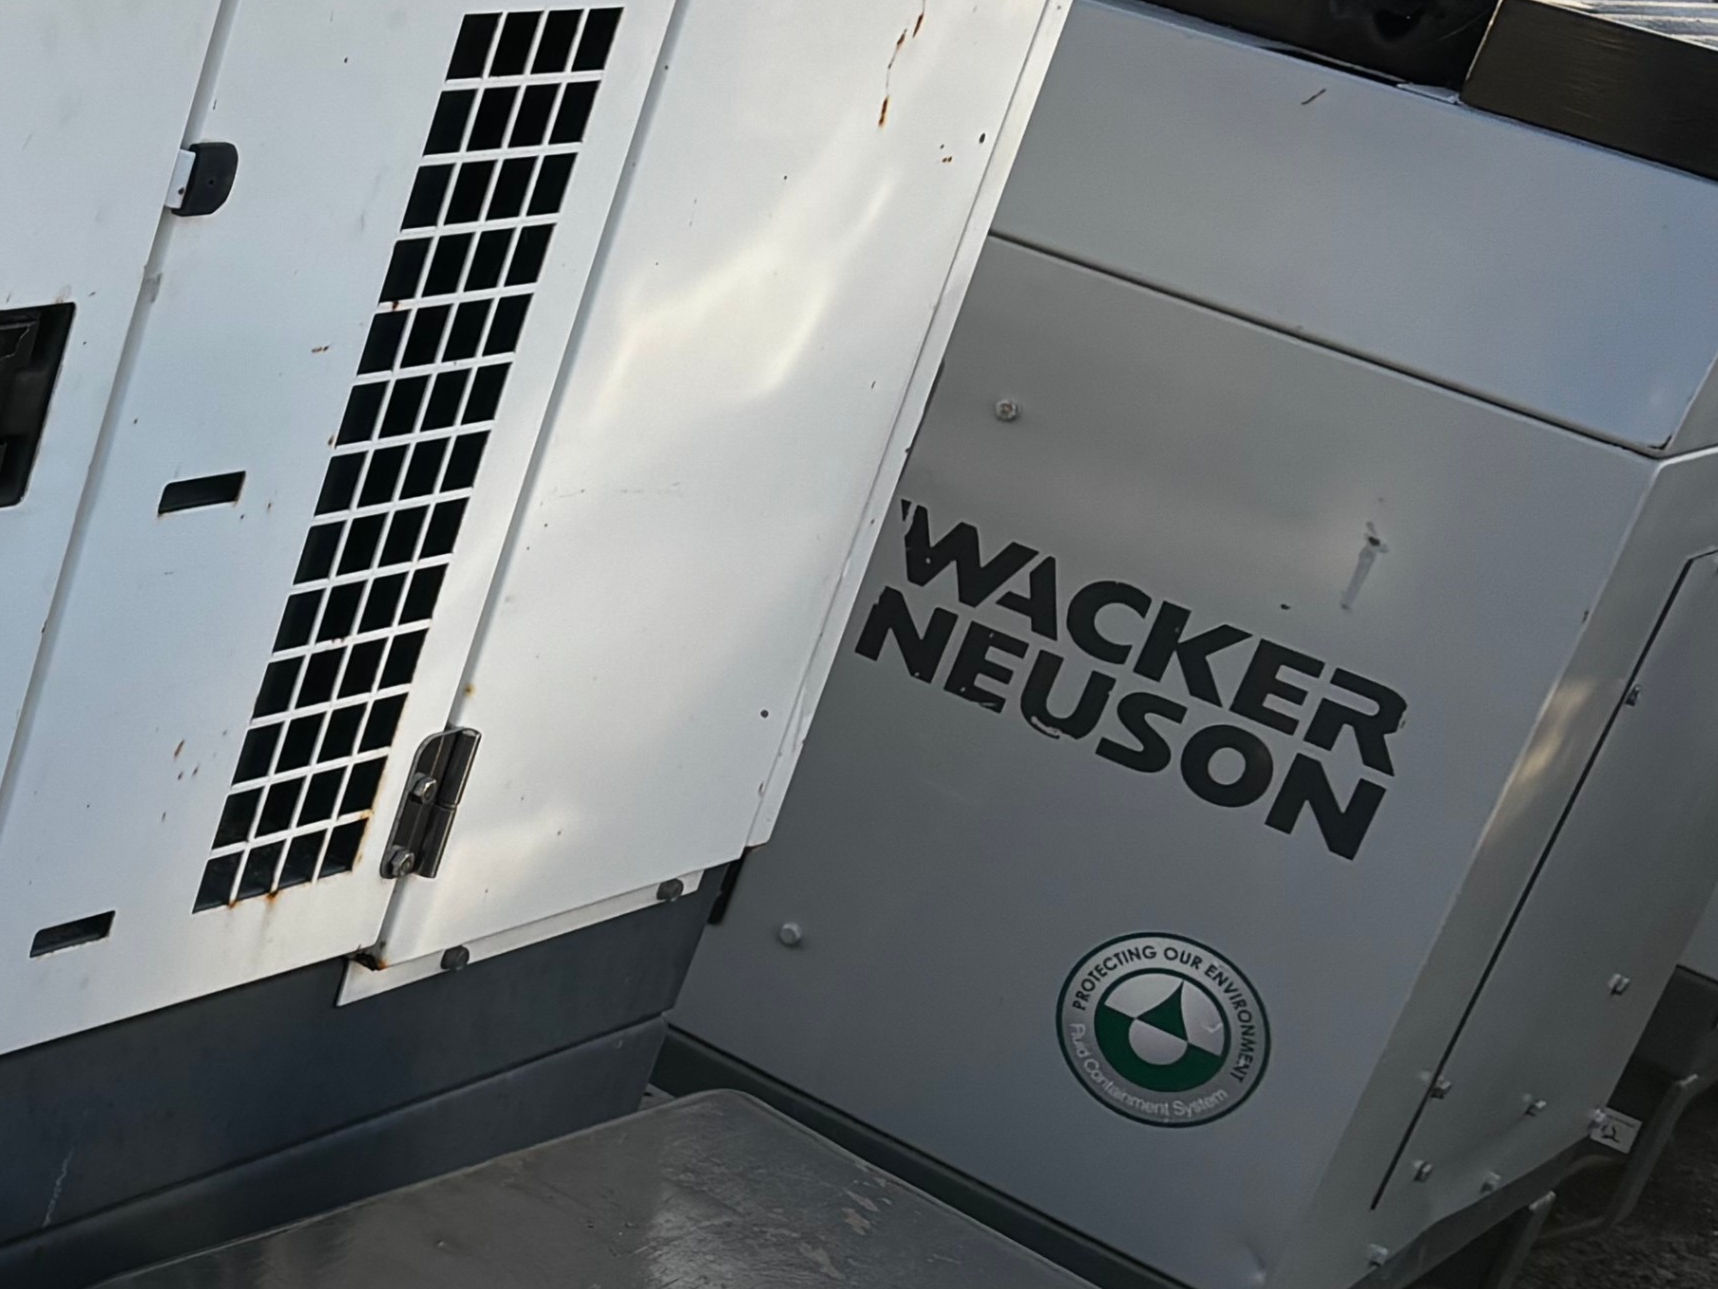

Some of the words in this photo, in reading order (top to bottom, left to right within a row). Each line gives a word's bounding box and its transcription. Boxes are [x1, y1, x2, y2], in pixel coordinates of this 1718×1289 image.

[854, 585, 1387, 861] NEUSON
[901, 498, 1408, 777] WACKER
[1072, 944, 1158, 1011] PROTECTING
[1163, 946, 1203, 971] OUR
[1204, 963, 1256, 1084] ENVIRONMENT
[1083, 1058, 1169, 1115] Containment
[1173, 1088, 1229, 1118] System
